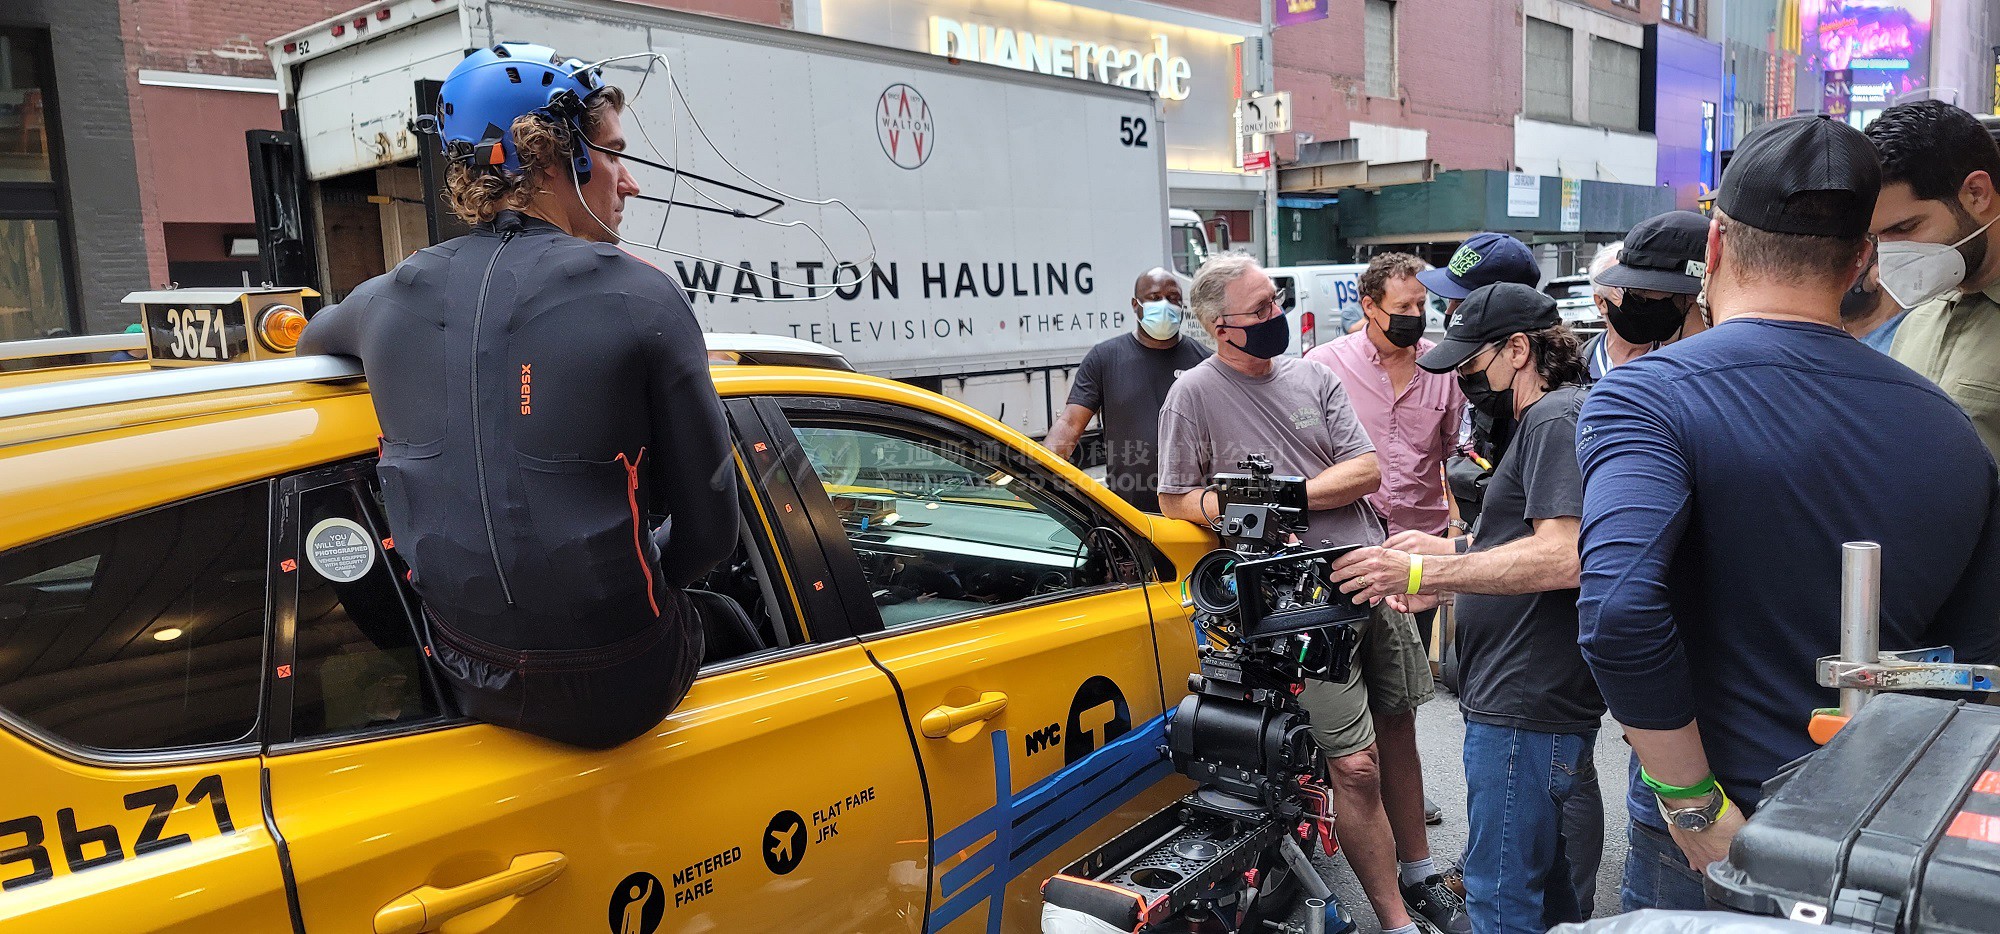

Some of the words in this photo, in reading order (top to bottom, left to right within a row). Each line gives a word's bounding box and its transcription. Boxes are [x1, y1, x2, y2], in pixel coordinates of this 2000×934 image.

[298, 40, 310, 56] 52
[882, 117, 931, 133] WALTON
[1120, 116, 1149, 148] 52
[1244, 123, 1263, 133] ONLY
[674, 260, 900, 304] WALTON
[922, 262, 1094, 299] HAULING
[167, 308, 229, 359] 36Z1
[789, 318, 974, 344] TELEVISION
[1022, 312, 1123, 334] THEATRE
[521, 363, 532, 416] xsens
[314, 541, 335, 550] WILL
[314, 545, 368, 557] PHOTOGRAPHED
[1025, 722, 1061, 757] NYC
[812, 800, 842, 827] FLAT
[845, 786, 876, 811] FARE
[815, 822, 839, 844] JFK
[672, 846, 742, 888] METERED
[674, 878, 714, 908] FARE
